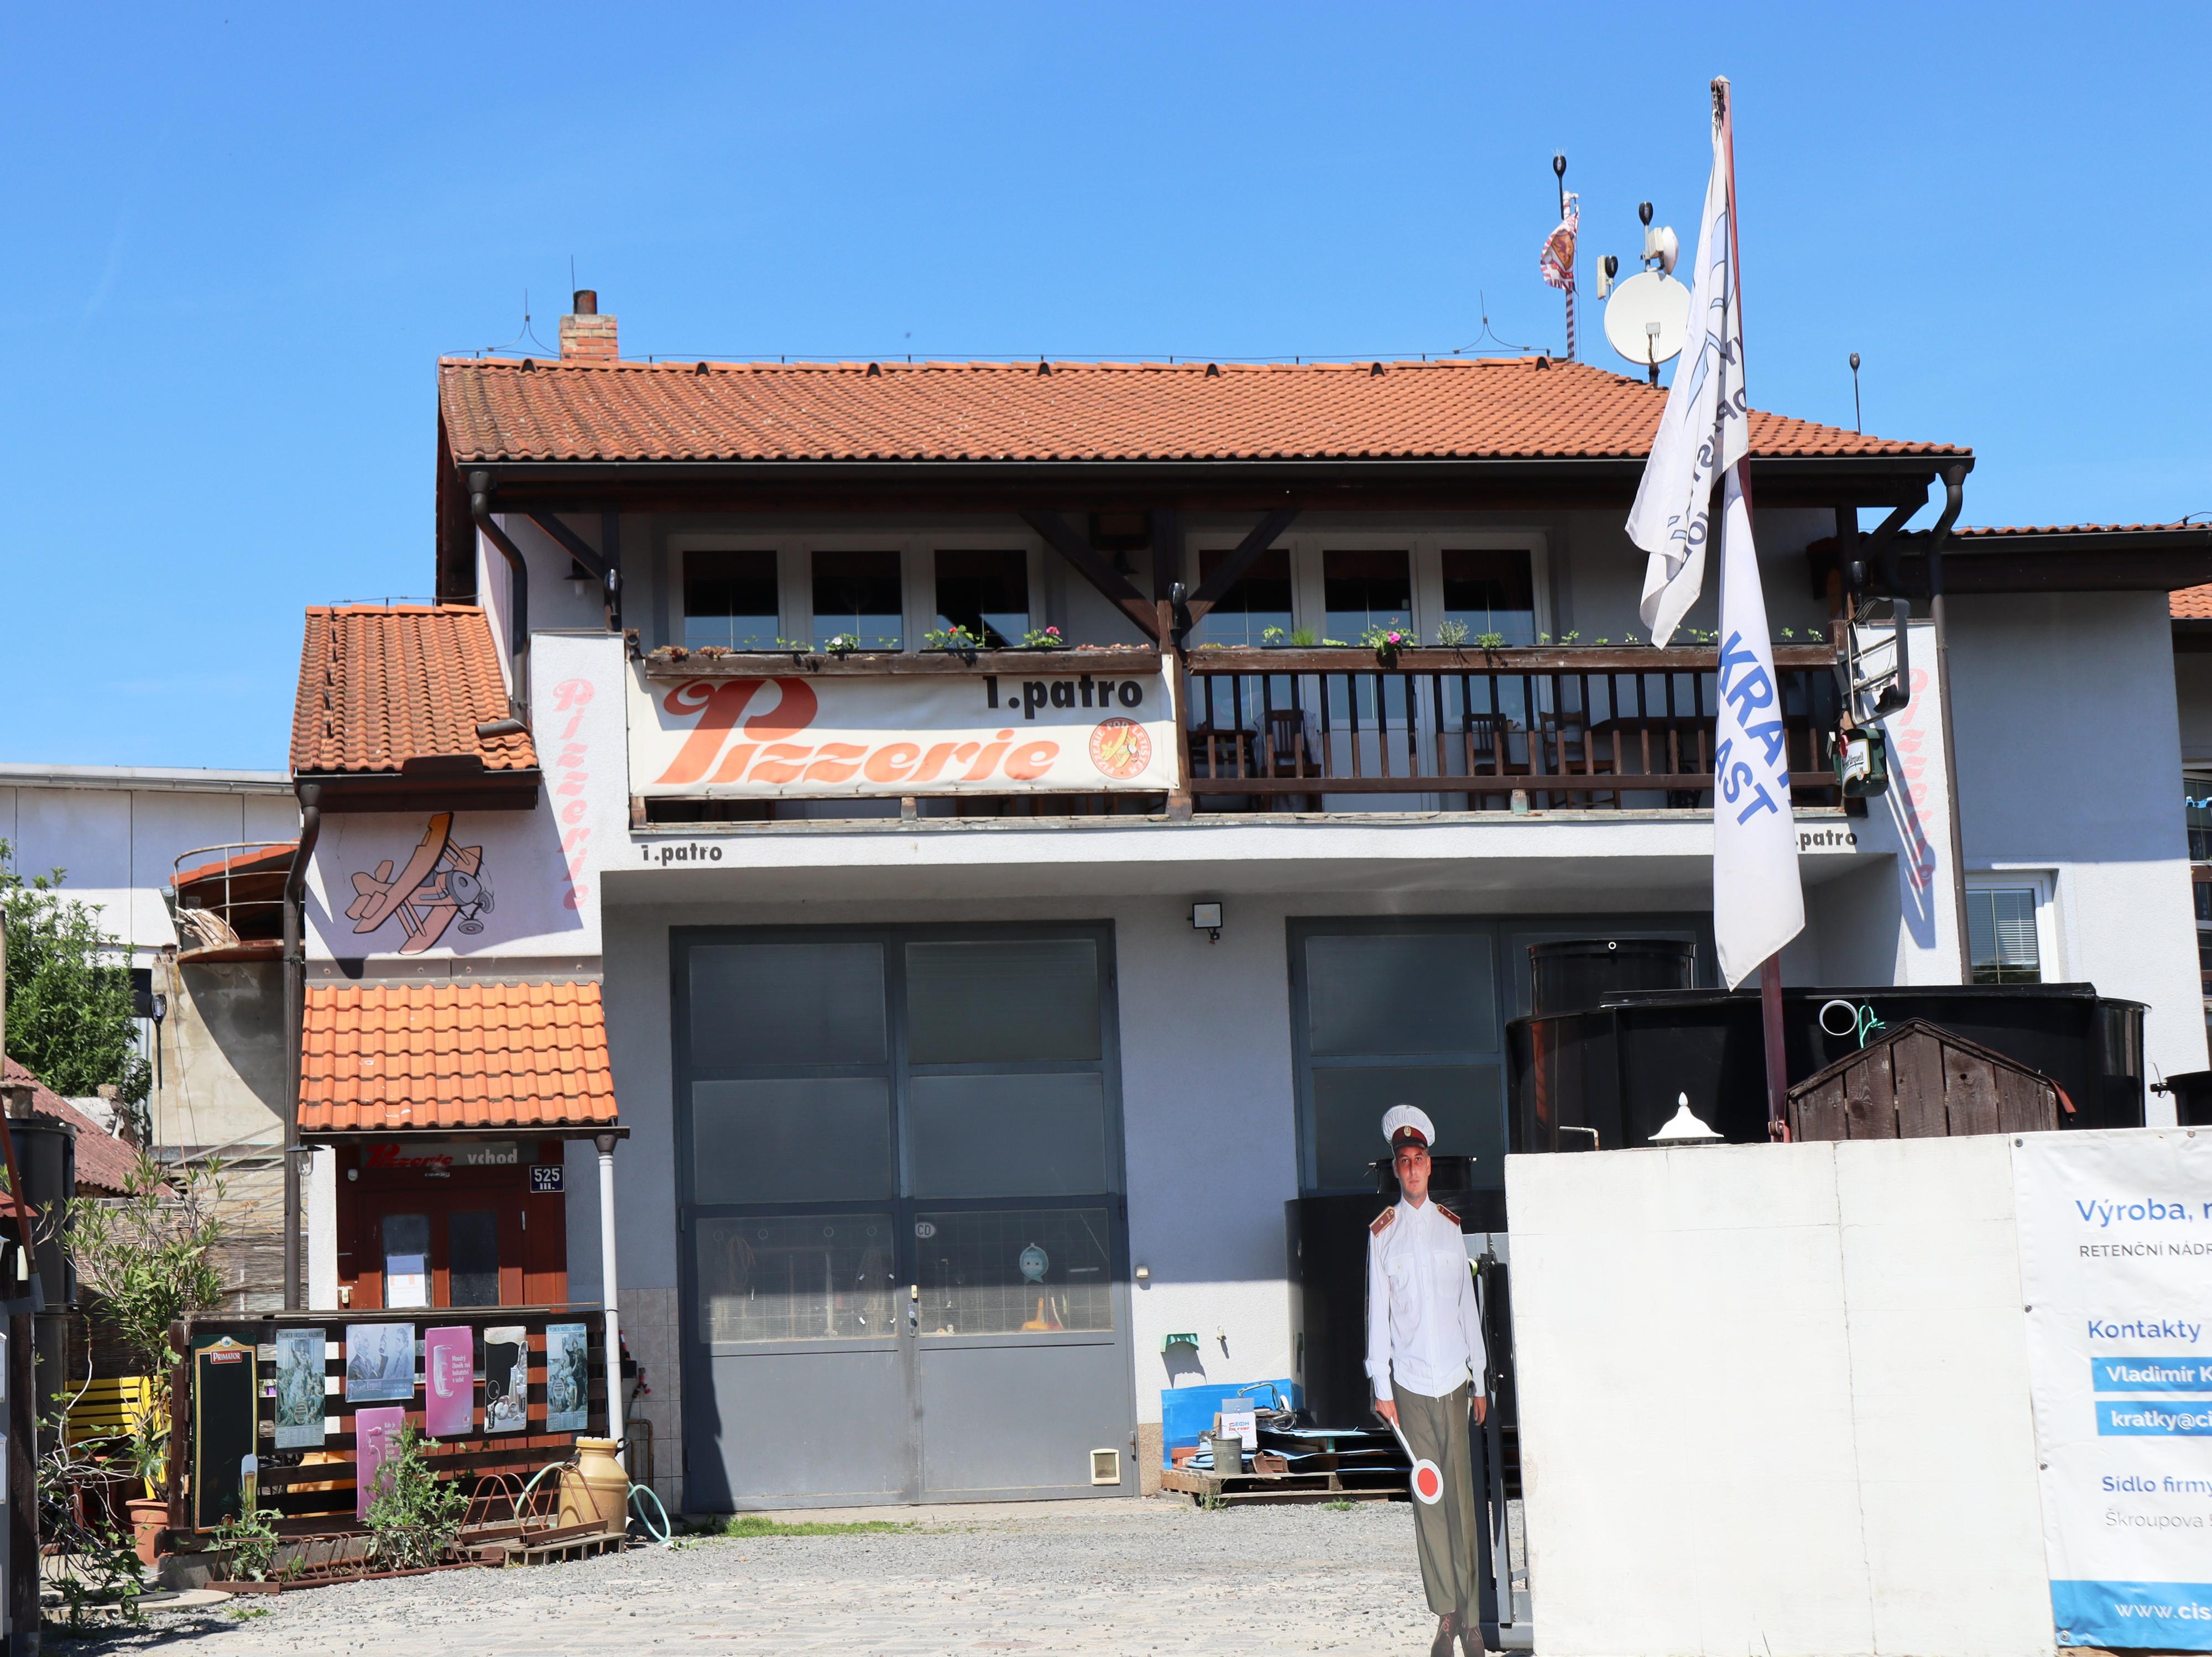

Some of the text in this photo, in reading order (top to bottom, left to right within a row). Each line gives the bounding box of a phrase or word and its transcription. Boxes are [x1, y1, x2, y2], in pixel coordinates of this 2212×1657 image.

[651, 678, 1060, 784] Pizzerie
[553, 678, 594, 910] Pizzerie
[467, 1148, 518, 1164] vchod
[534, 1168, 560, 1182] 525
[2075, 1198, 2193, 1228] Výroba,
[918, 1225, 931, 1235] CD
[2079, 1241, 2163, 1257] RETENČNÍ
[2088, 1319, 2201, 1343] Kontakty
[213, 1352, 241, 1362] PRIMATOR
[2105, 1508, 2204, 1530] Škroupova
